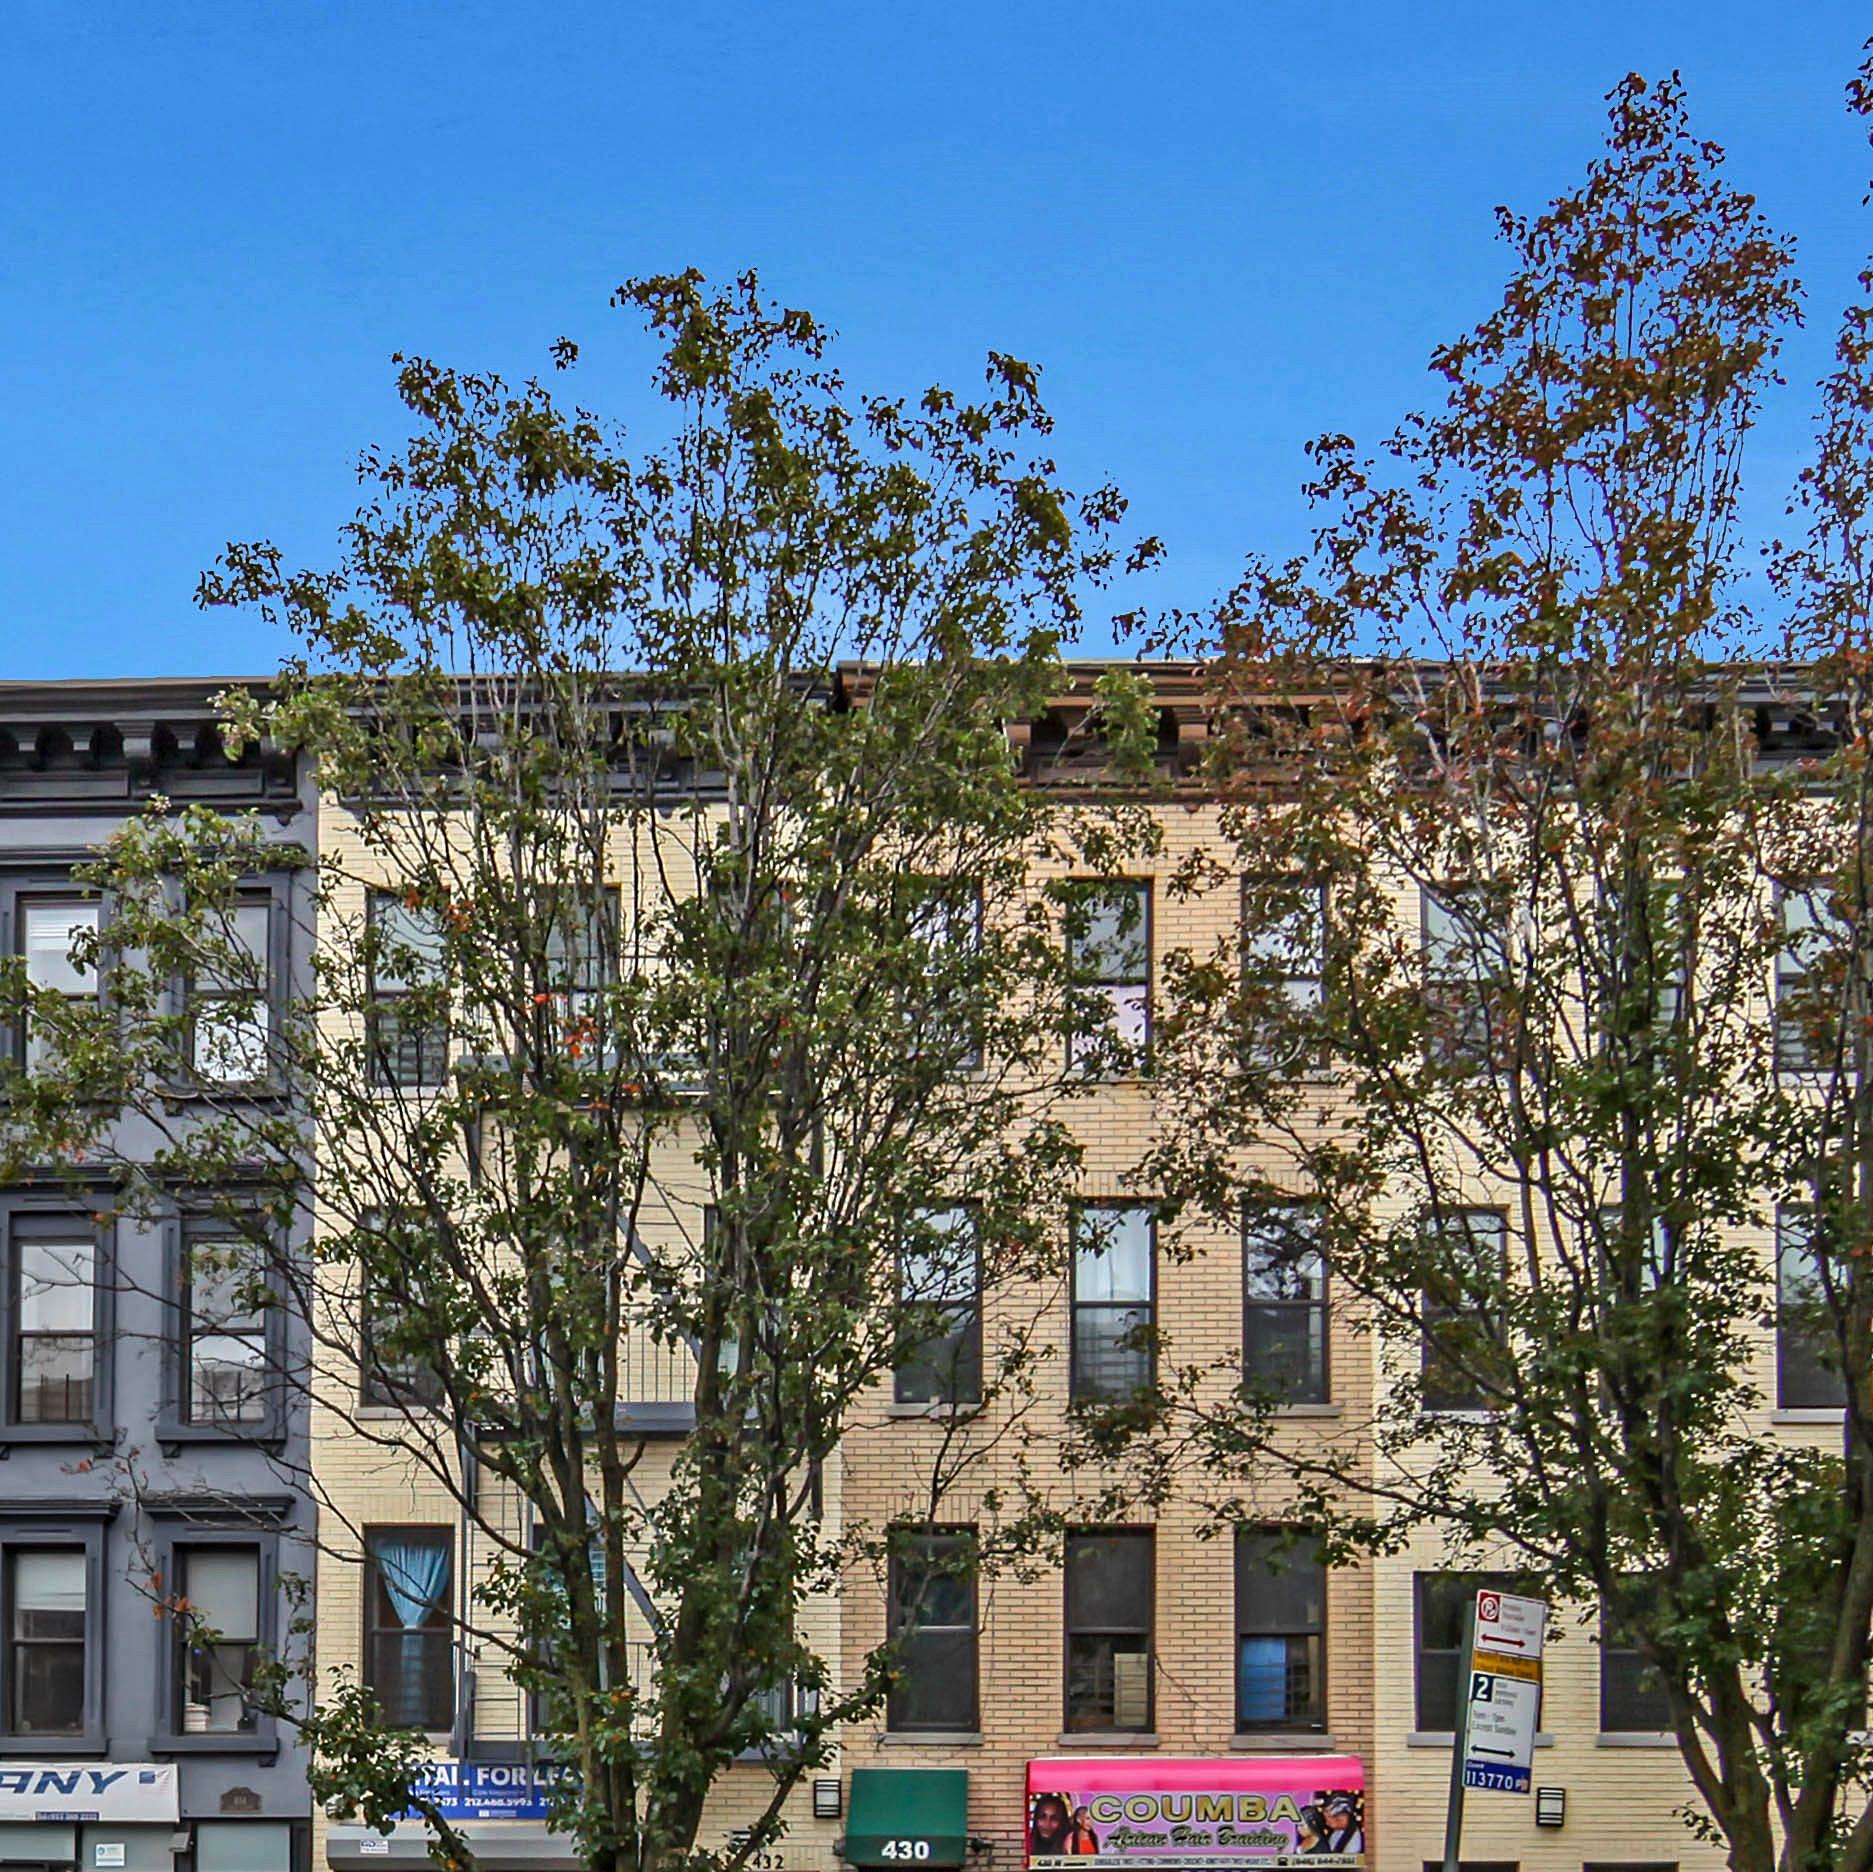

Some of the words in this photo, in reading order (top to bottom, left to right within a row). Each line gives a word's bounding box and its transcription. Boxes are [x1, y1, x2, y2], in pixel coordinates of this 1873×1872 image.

[1475, 1676, 1489, 1699] 2
[477, 1767, 526, 1787] FOR
[1466, 1769, 1514, 1790] 113770
[1089, 1794, 1301, 1824] COUMBA
[1170, 1825, 1212, 1847] Hair
[1217, 1825, 1290, 1851] Braiding
[881, 1840, 930, 1860] 430
[752, 1852, 785, 1870] 432
